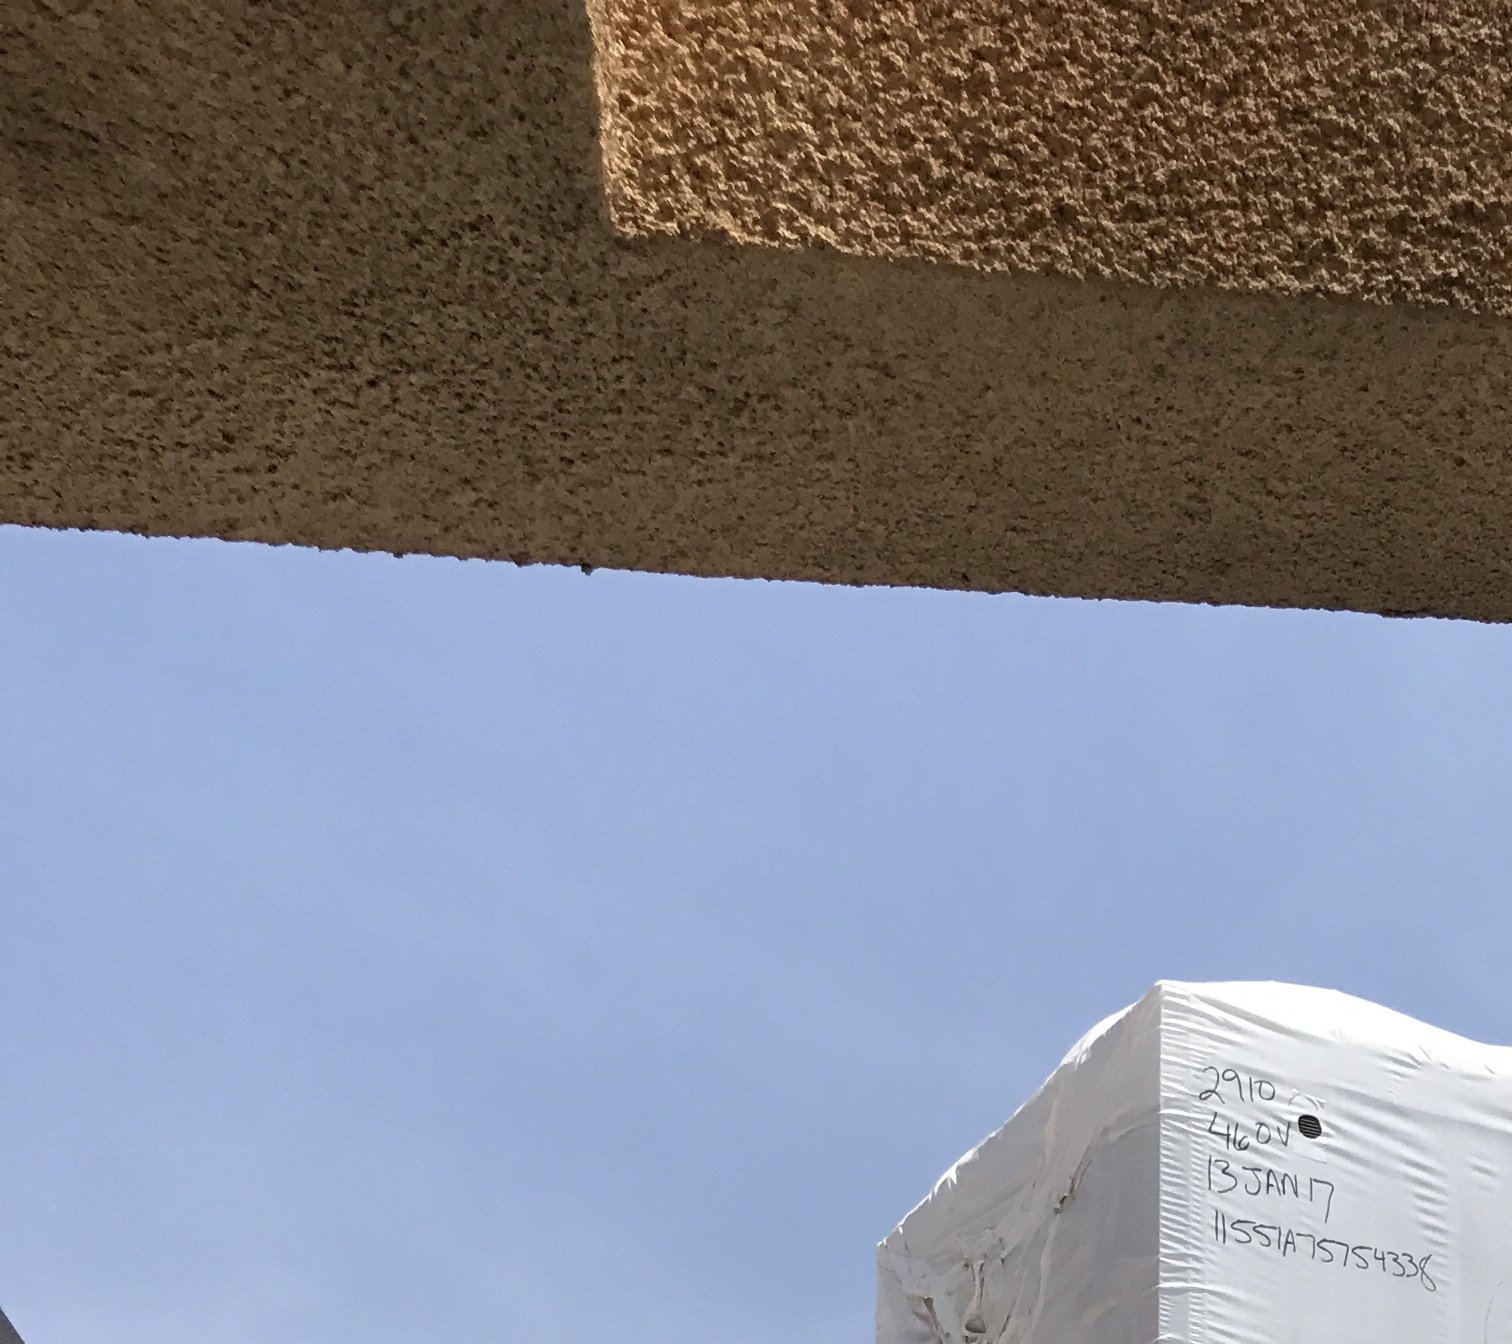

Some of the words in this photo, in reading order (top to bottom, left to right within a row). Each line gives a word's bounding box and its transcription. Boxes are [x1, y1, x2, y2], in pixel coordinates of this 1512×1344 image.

[1199, 1066, 1276, 1104] 2910
[1241, 1165, 1299, 1198] JAN
[1309, 1176, 1335, 1225] 17
